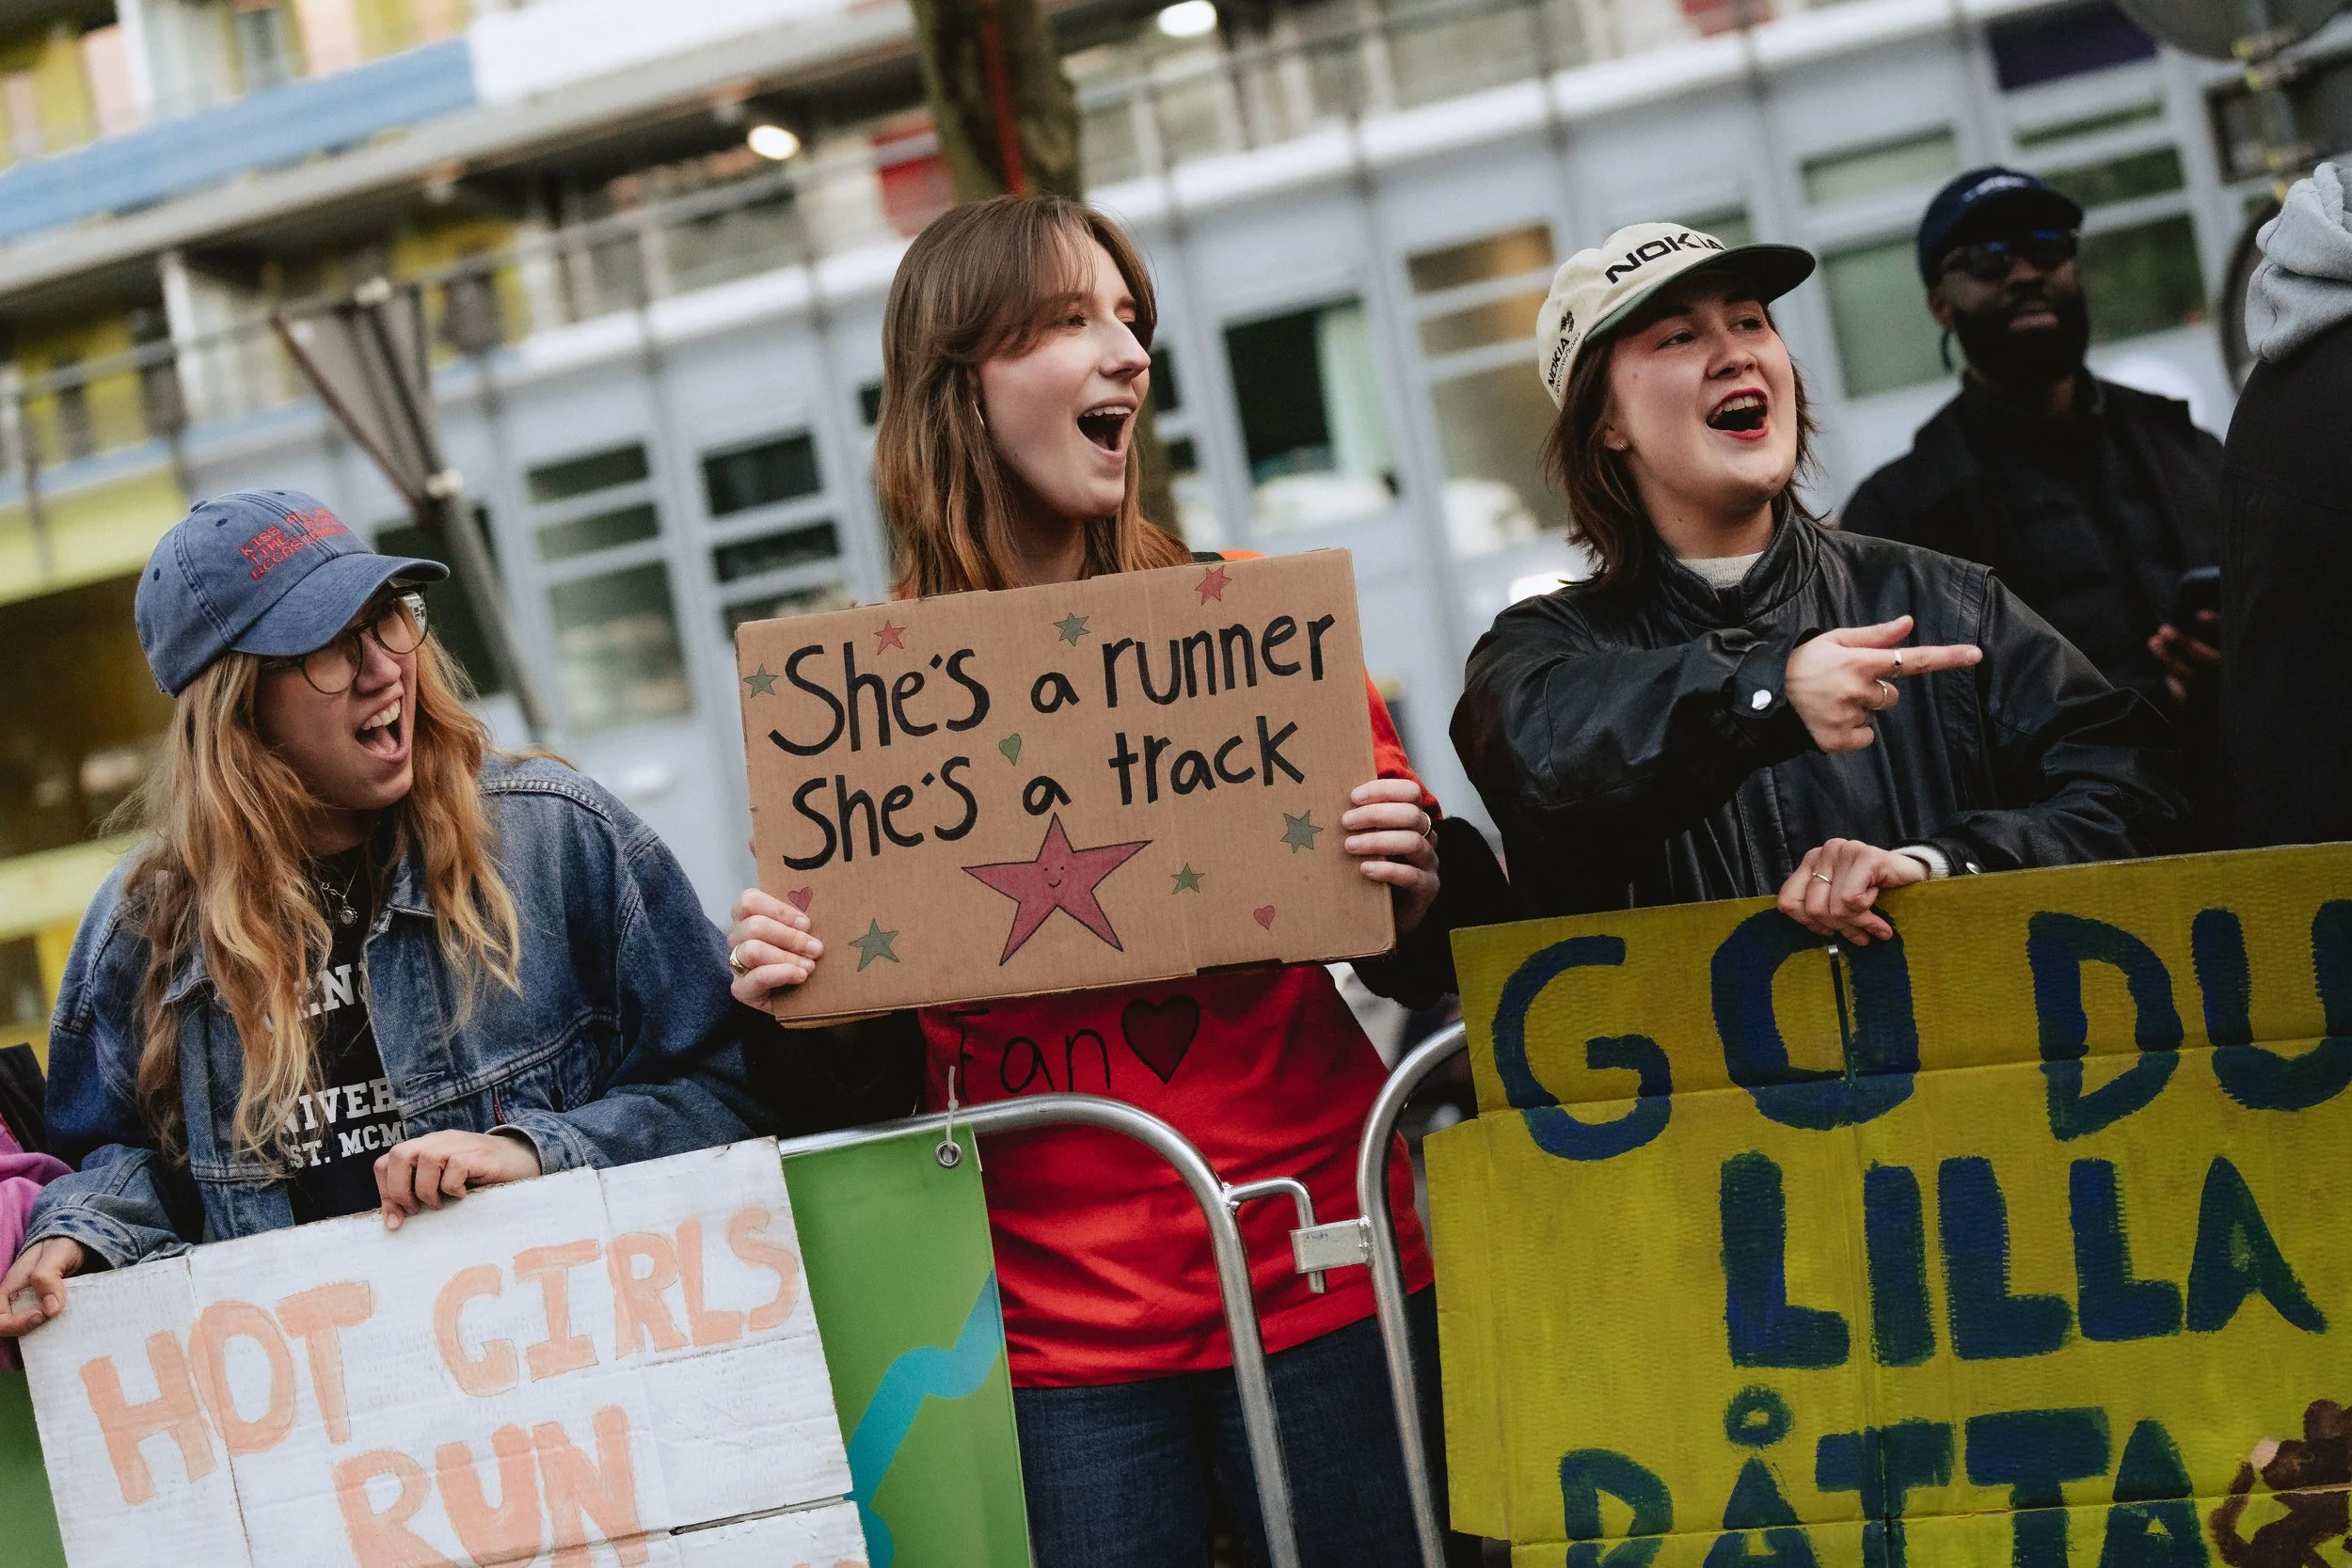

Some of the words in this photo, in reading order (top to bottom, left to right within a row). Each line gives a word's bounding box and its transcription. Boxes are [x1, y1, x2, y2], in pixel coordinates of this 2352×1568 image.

[1605, 232, 1726, 285] NOKIA
[1548, 338, 1570, 388] NOKIA
[240, 525, 281, 558] KISS
[768, 641, 991, 756] She's
[1030, 672, 1081, 714] a
[1102, 613, 1336, 708] runner
[782, 755, 978, 871] She's
[1022, 775, 1073, 816] a
[1107, 715, 1305, 806] track
[948, 1007, 1112, 1103] Fan
[1492, 907, 1922, 1161] GO
[2026, 899, 2352, 1142] DU
[1720, 1149, 2329, 1370] LILLA
[79, 1281, 373, 1505] HOT
[433, 1207, 800, 1398] GIRLS
[333, 1406, 649, 1568] RUN
